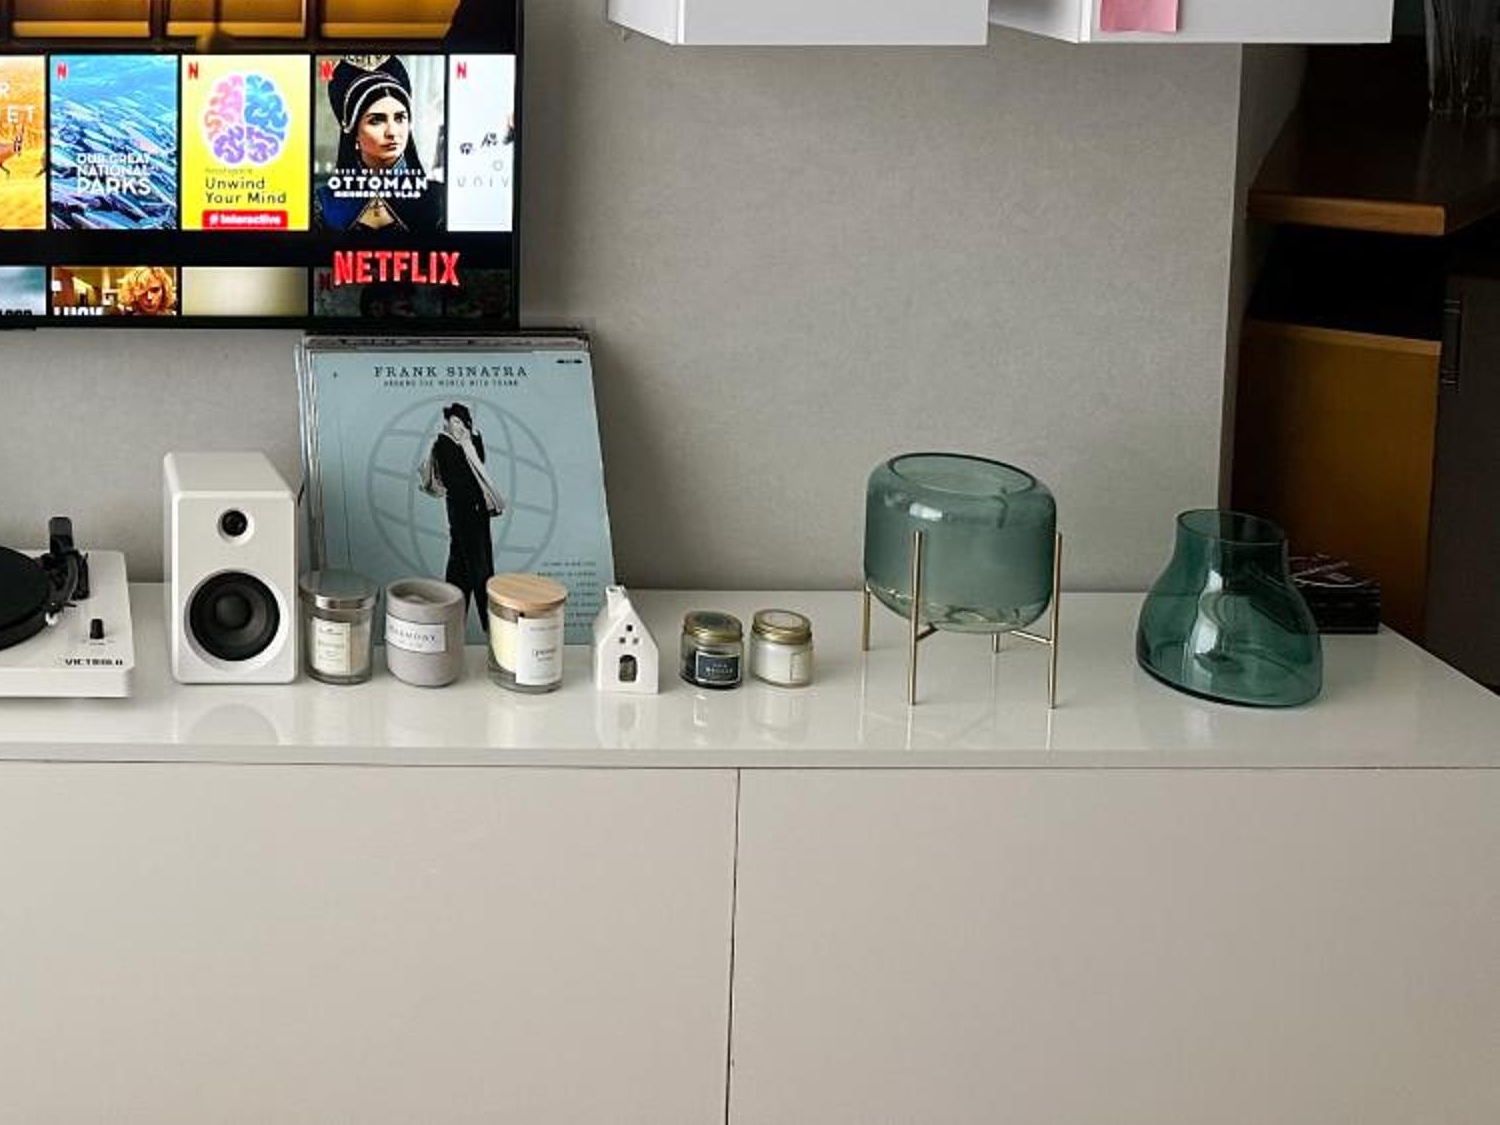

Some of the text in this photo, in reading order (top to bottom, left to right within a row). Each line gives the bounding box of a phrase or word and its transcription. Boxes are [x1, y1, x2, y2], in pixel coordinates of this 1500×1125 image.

[77, 165, 149, 175] NATIONAL
[77, 178, 151, 195] PARKS
[205, 177, 265, 189] Unwind
[328, 176, 428, 190] OTTOMAN
[206, 192, 287, 204] Your Mind
[334, 250, 460, 287] NETFLIX
[374, 365, 530, 378] FRANK SINATRA
